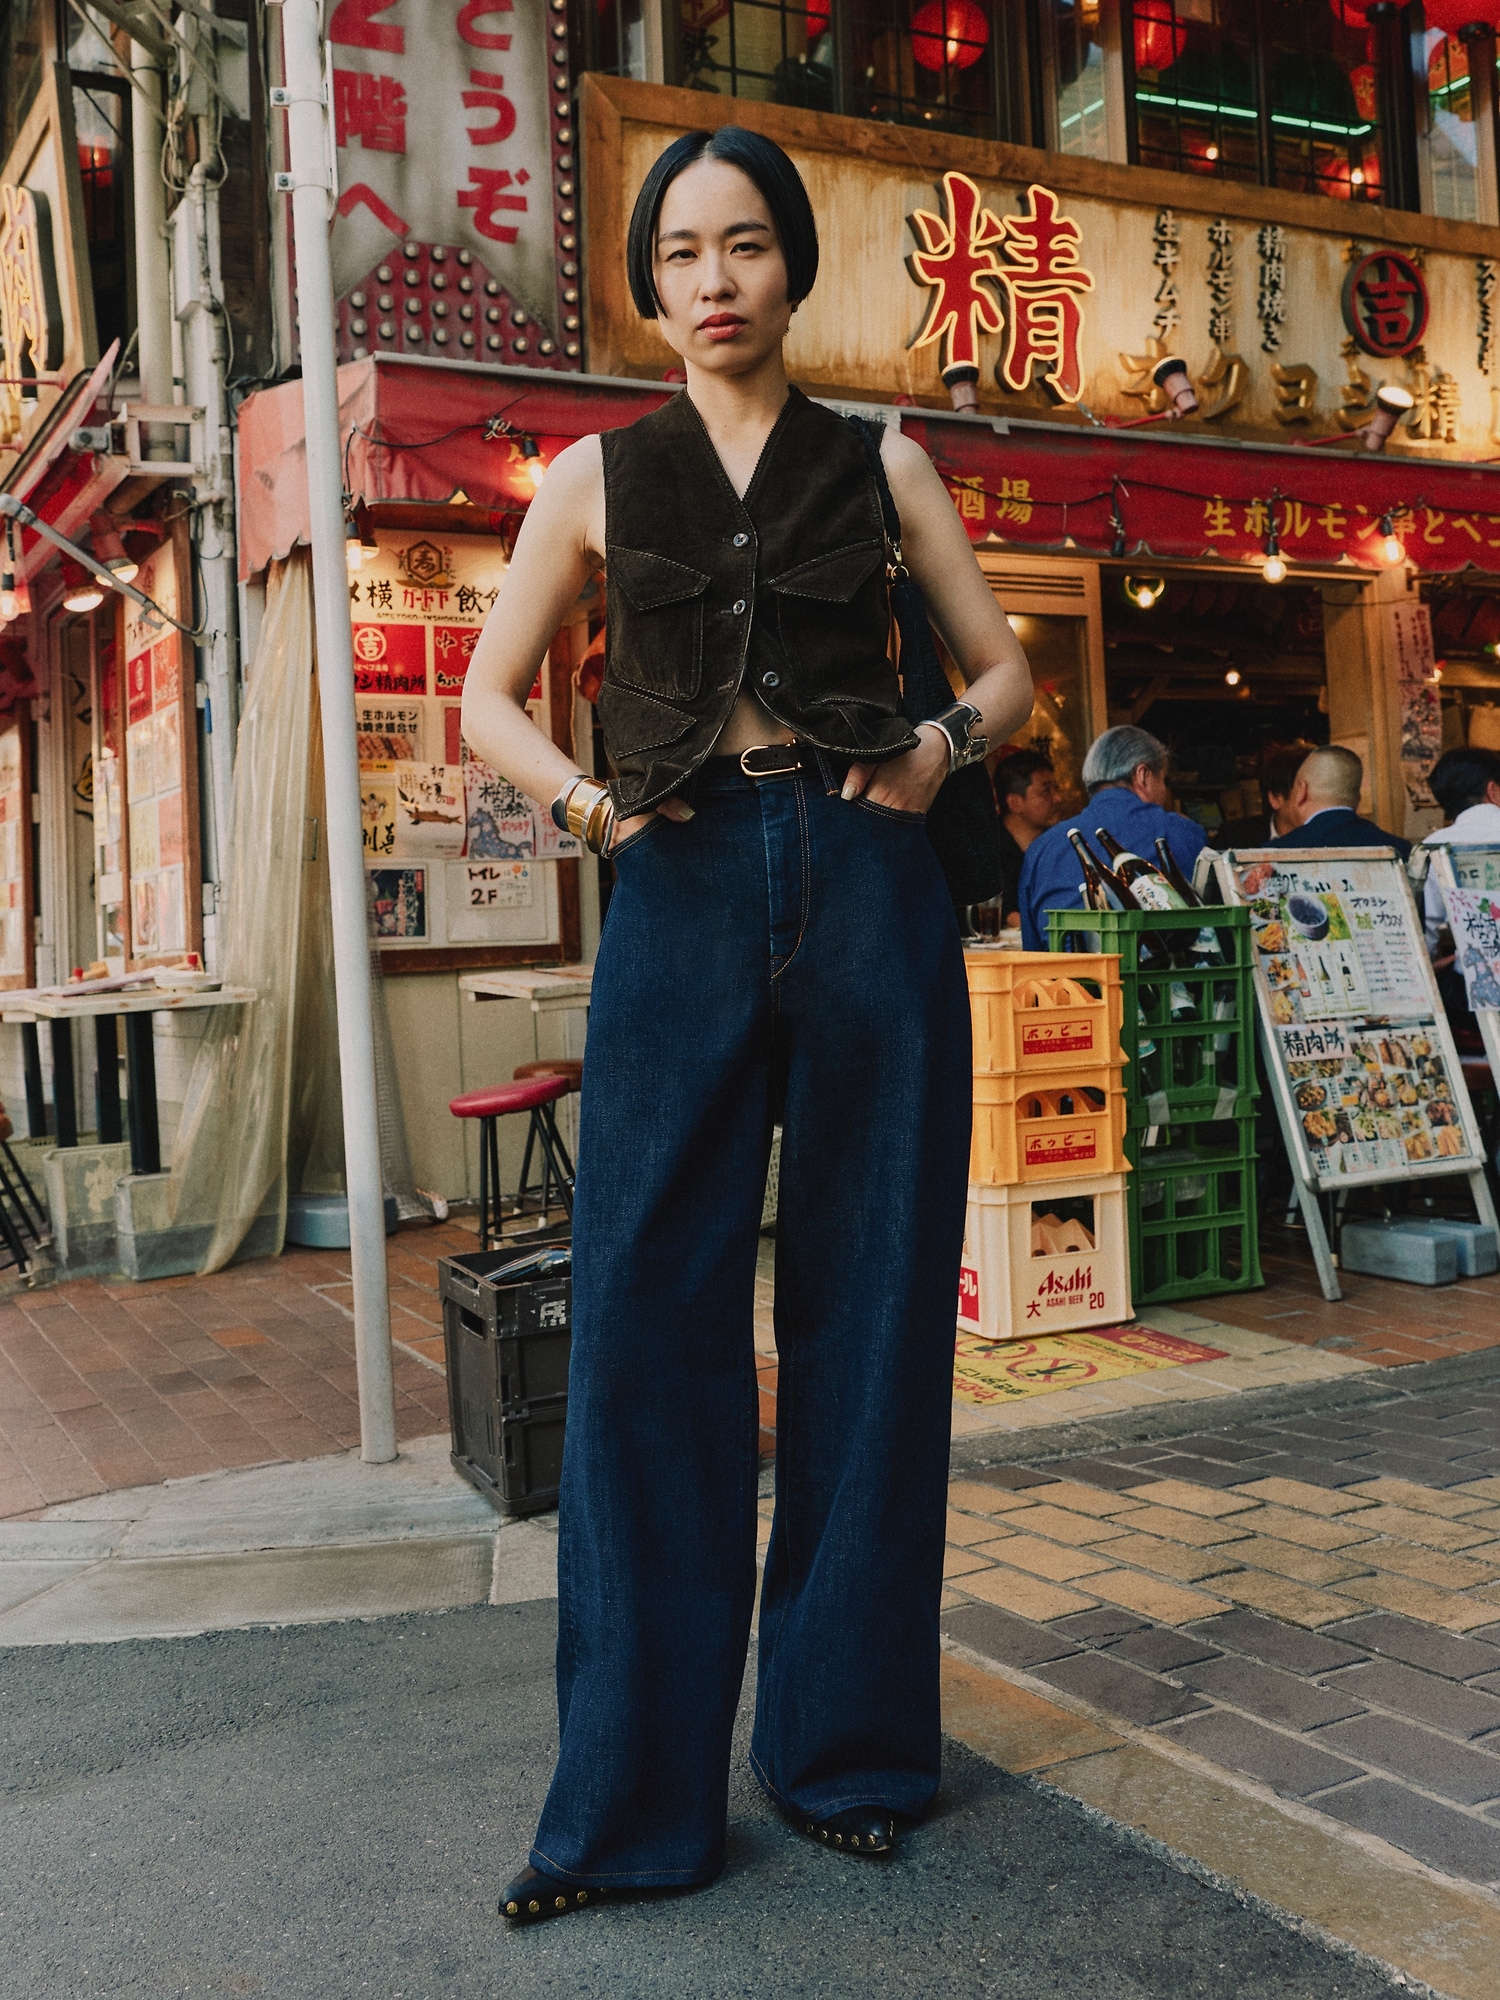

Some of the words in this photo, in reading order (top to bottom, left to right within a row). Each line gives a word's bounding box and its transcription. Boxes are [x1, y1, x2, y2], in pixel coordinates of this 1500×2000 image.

[911, 170, 1096, 404] 精
[1153, 208, 1181, 342] 生キムチ
[1206, 219, 1234, 346] ホルモン串
[1257, 225, 1287, 353] 精肉焼き
[950, 475, 1034, 526] 酒場
[362, 710, 418, 721] 生ホルモン
[1027, 1024, 1090, 1040] ホッピー
[1283, 1026, 1346, 1058] 精肉所
[1030, 1133, 1092, 1150] ホッピー
[1038, 1265, 1092, 1297] Asahi
[1026, 1300, 1042, 1319] 大
[1046, 1297, 1067, 1307] ASAHI
[1068, 1294, 1084, 1305] BEER
[1089, 1291, 1106, 1311] 20
